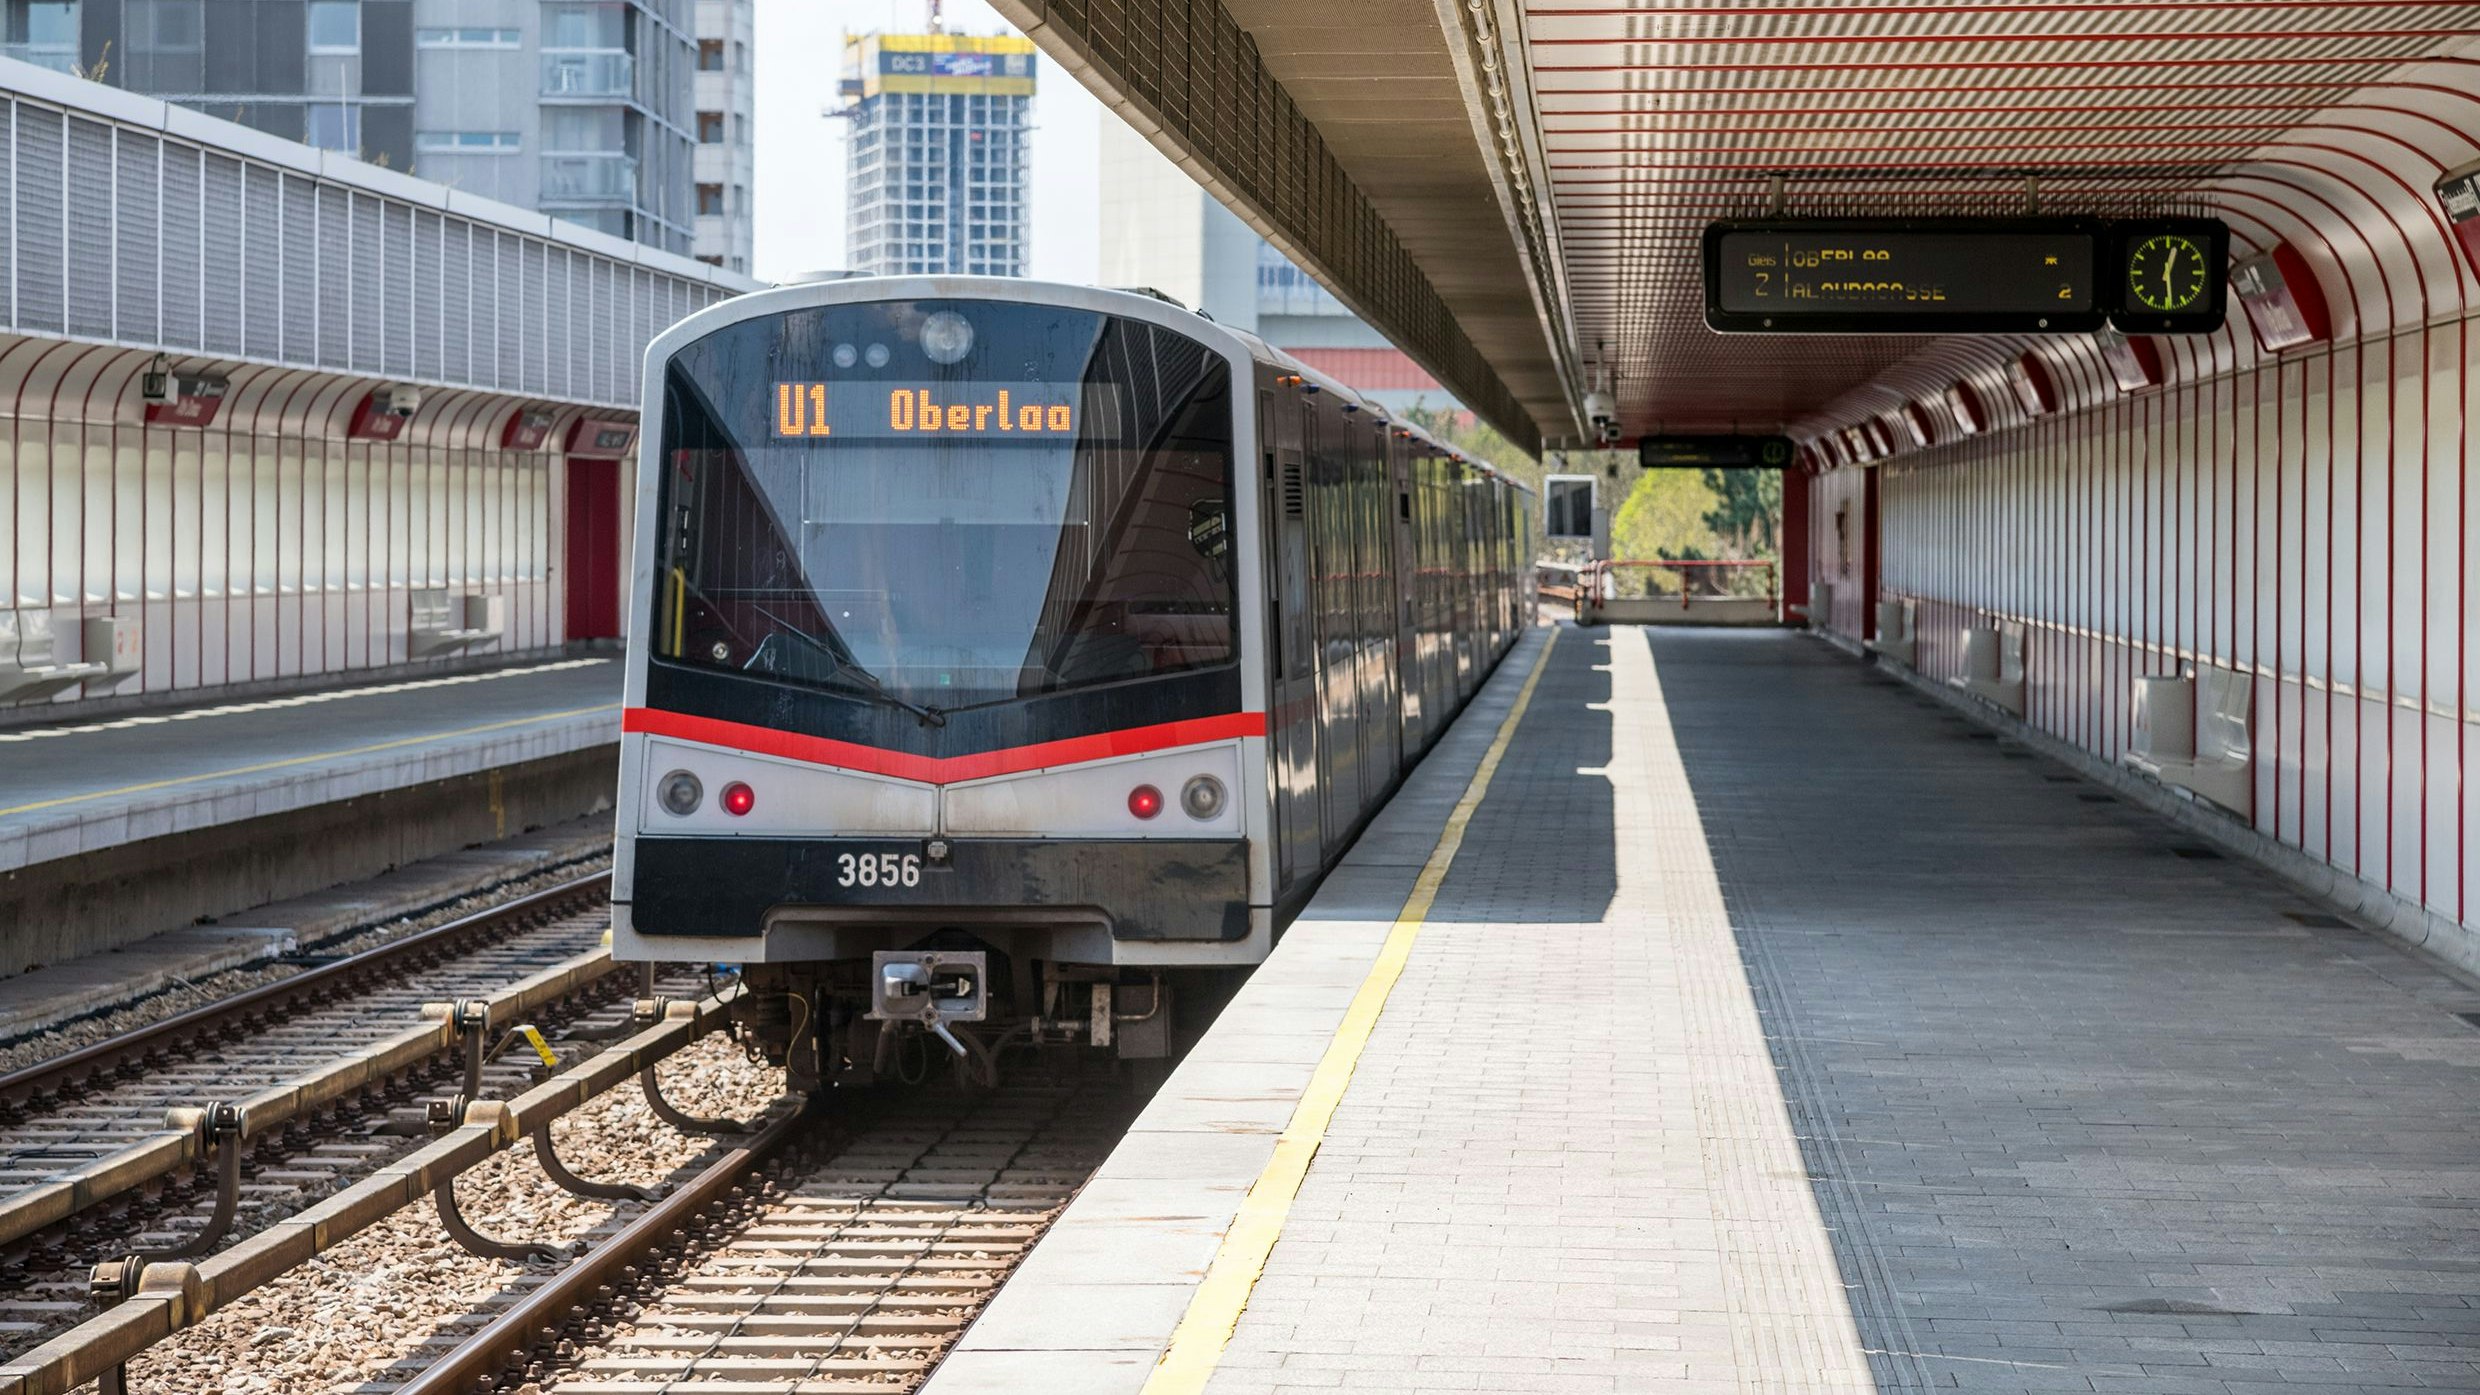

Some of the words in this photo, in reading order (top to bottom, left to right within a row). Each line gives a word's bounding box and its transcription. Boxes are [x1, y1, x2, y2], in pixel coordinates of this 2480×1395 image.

[892, 55, 926, 73] DC3
[1748, 254, 1776, 267] Gleis
[2058, 284, 2072, 299] 2
[779, 384, 830, 435] U1
[891, 389, 1071, 431] Oberlaa
[838, 853, 920, 887] 3856
